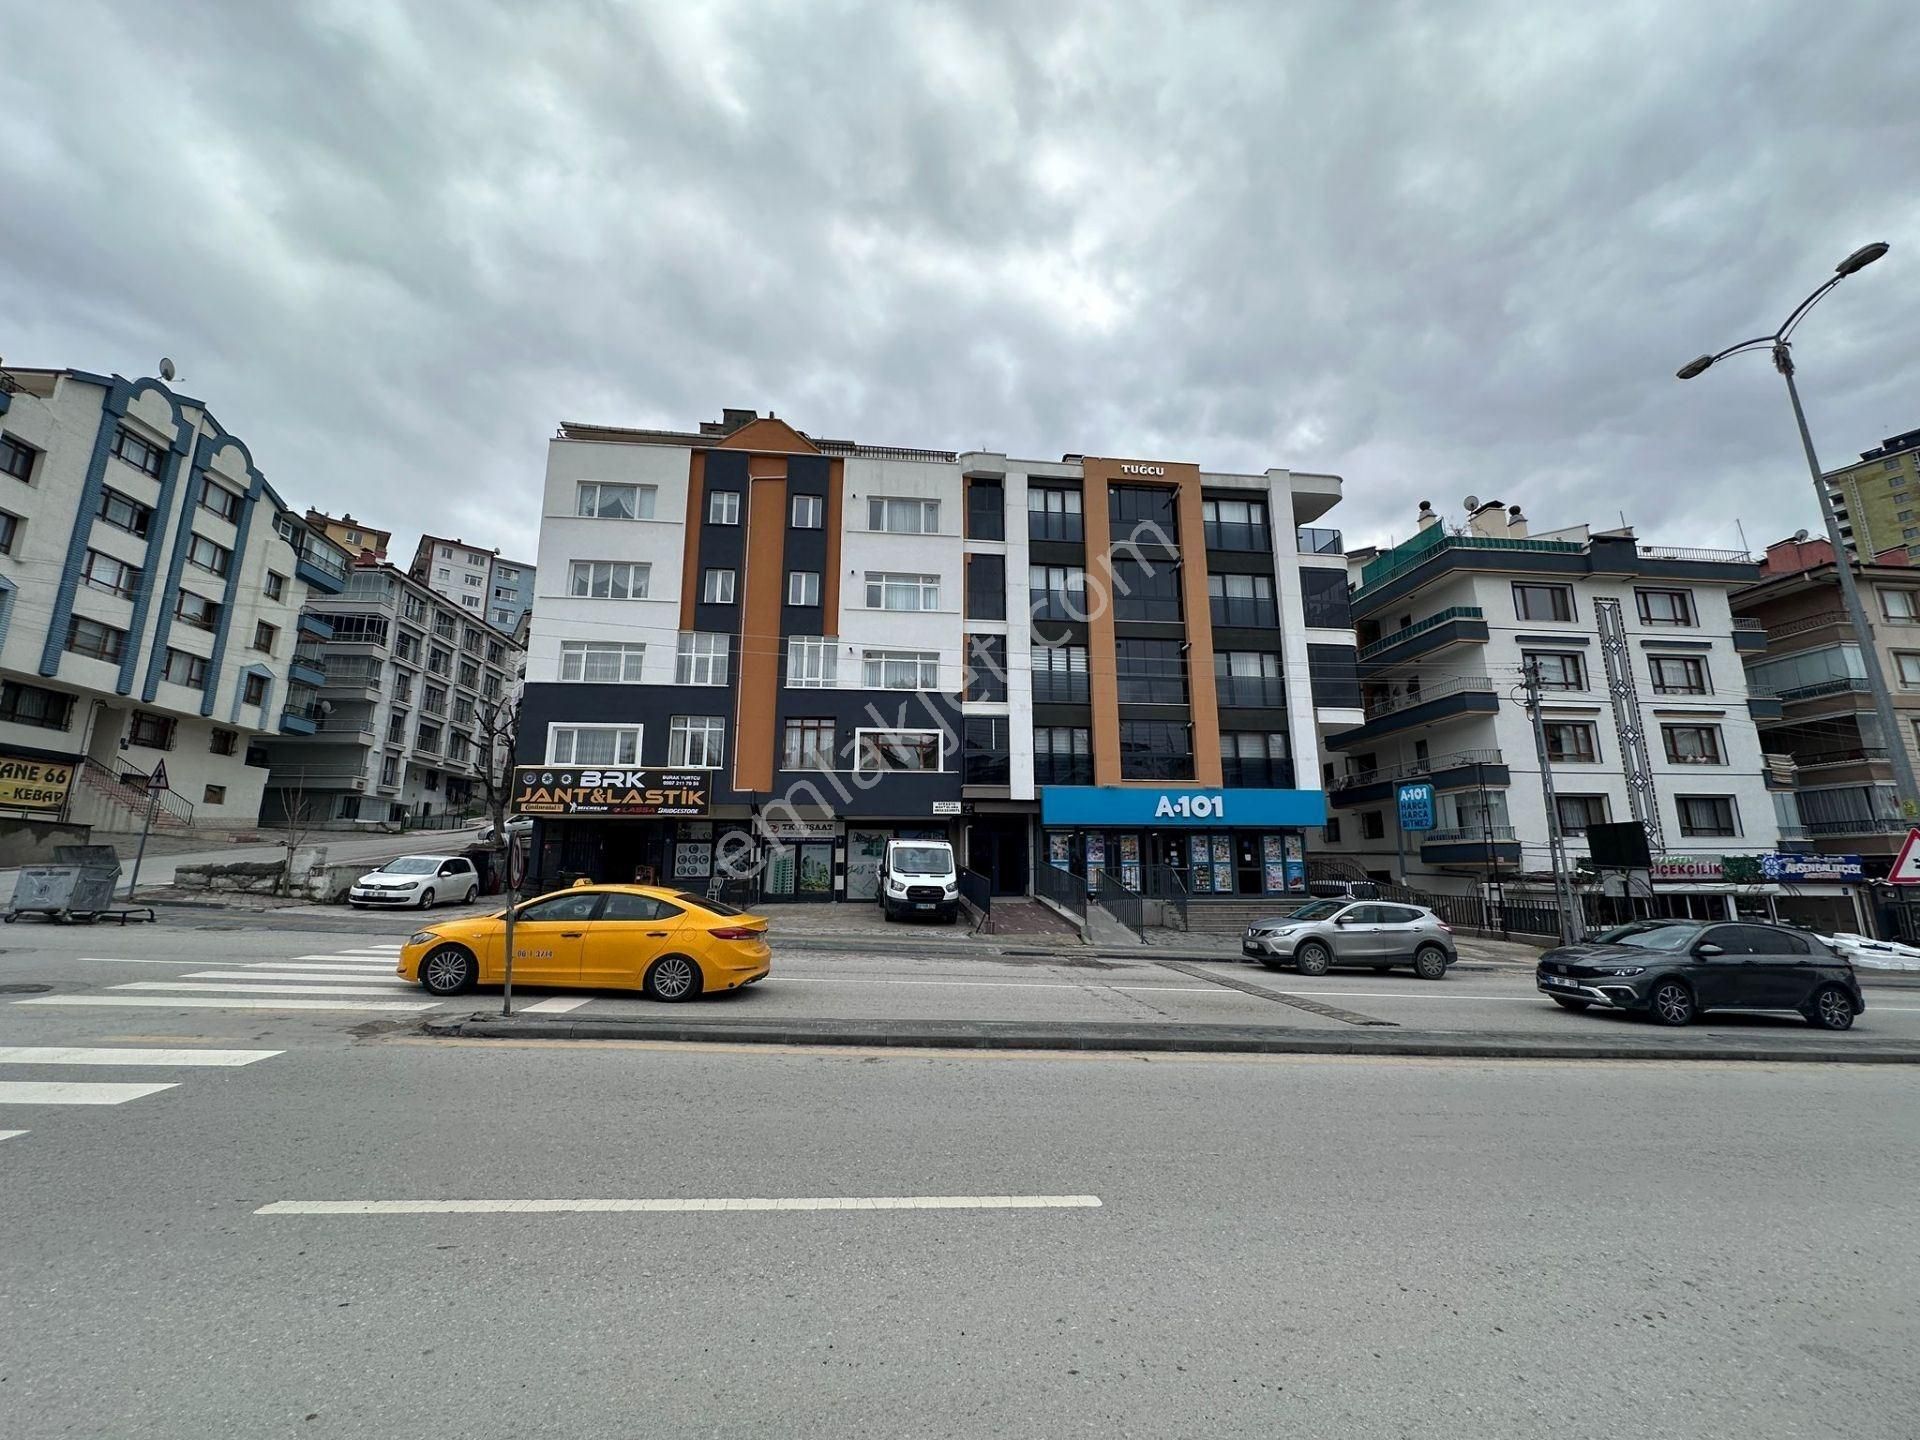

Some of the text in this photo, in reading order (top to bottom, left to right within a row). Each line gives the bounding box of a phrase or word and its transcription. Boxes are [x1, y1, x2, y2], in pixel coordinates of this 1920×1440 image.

[1121, 463, 1164, 476] TUĞCU
[0, 762, 67, 784] ANE 66
[580, 770, 646, 789] BRK
[13, 787, 64, 802] KEBAP
[516, 786, 705, 805] JANT&LASTİK
[1400, 801, 1428, 810] HARCA
